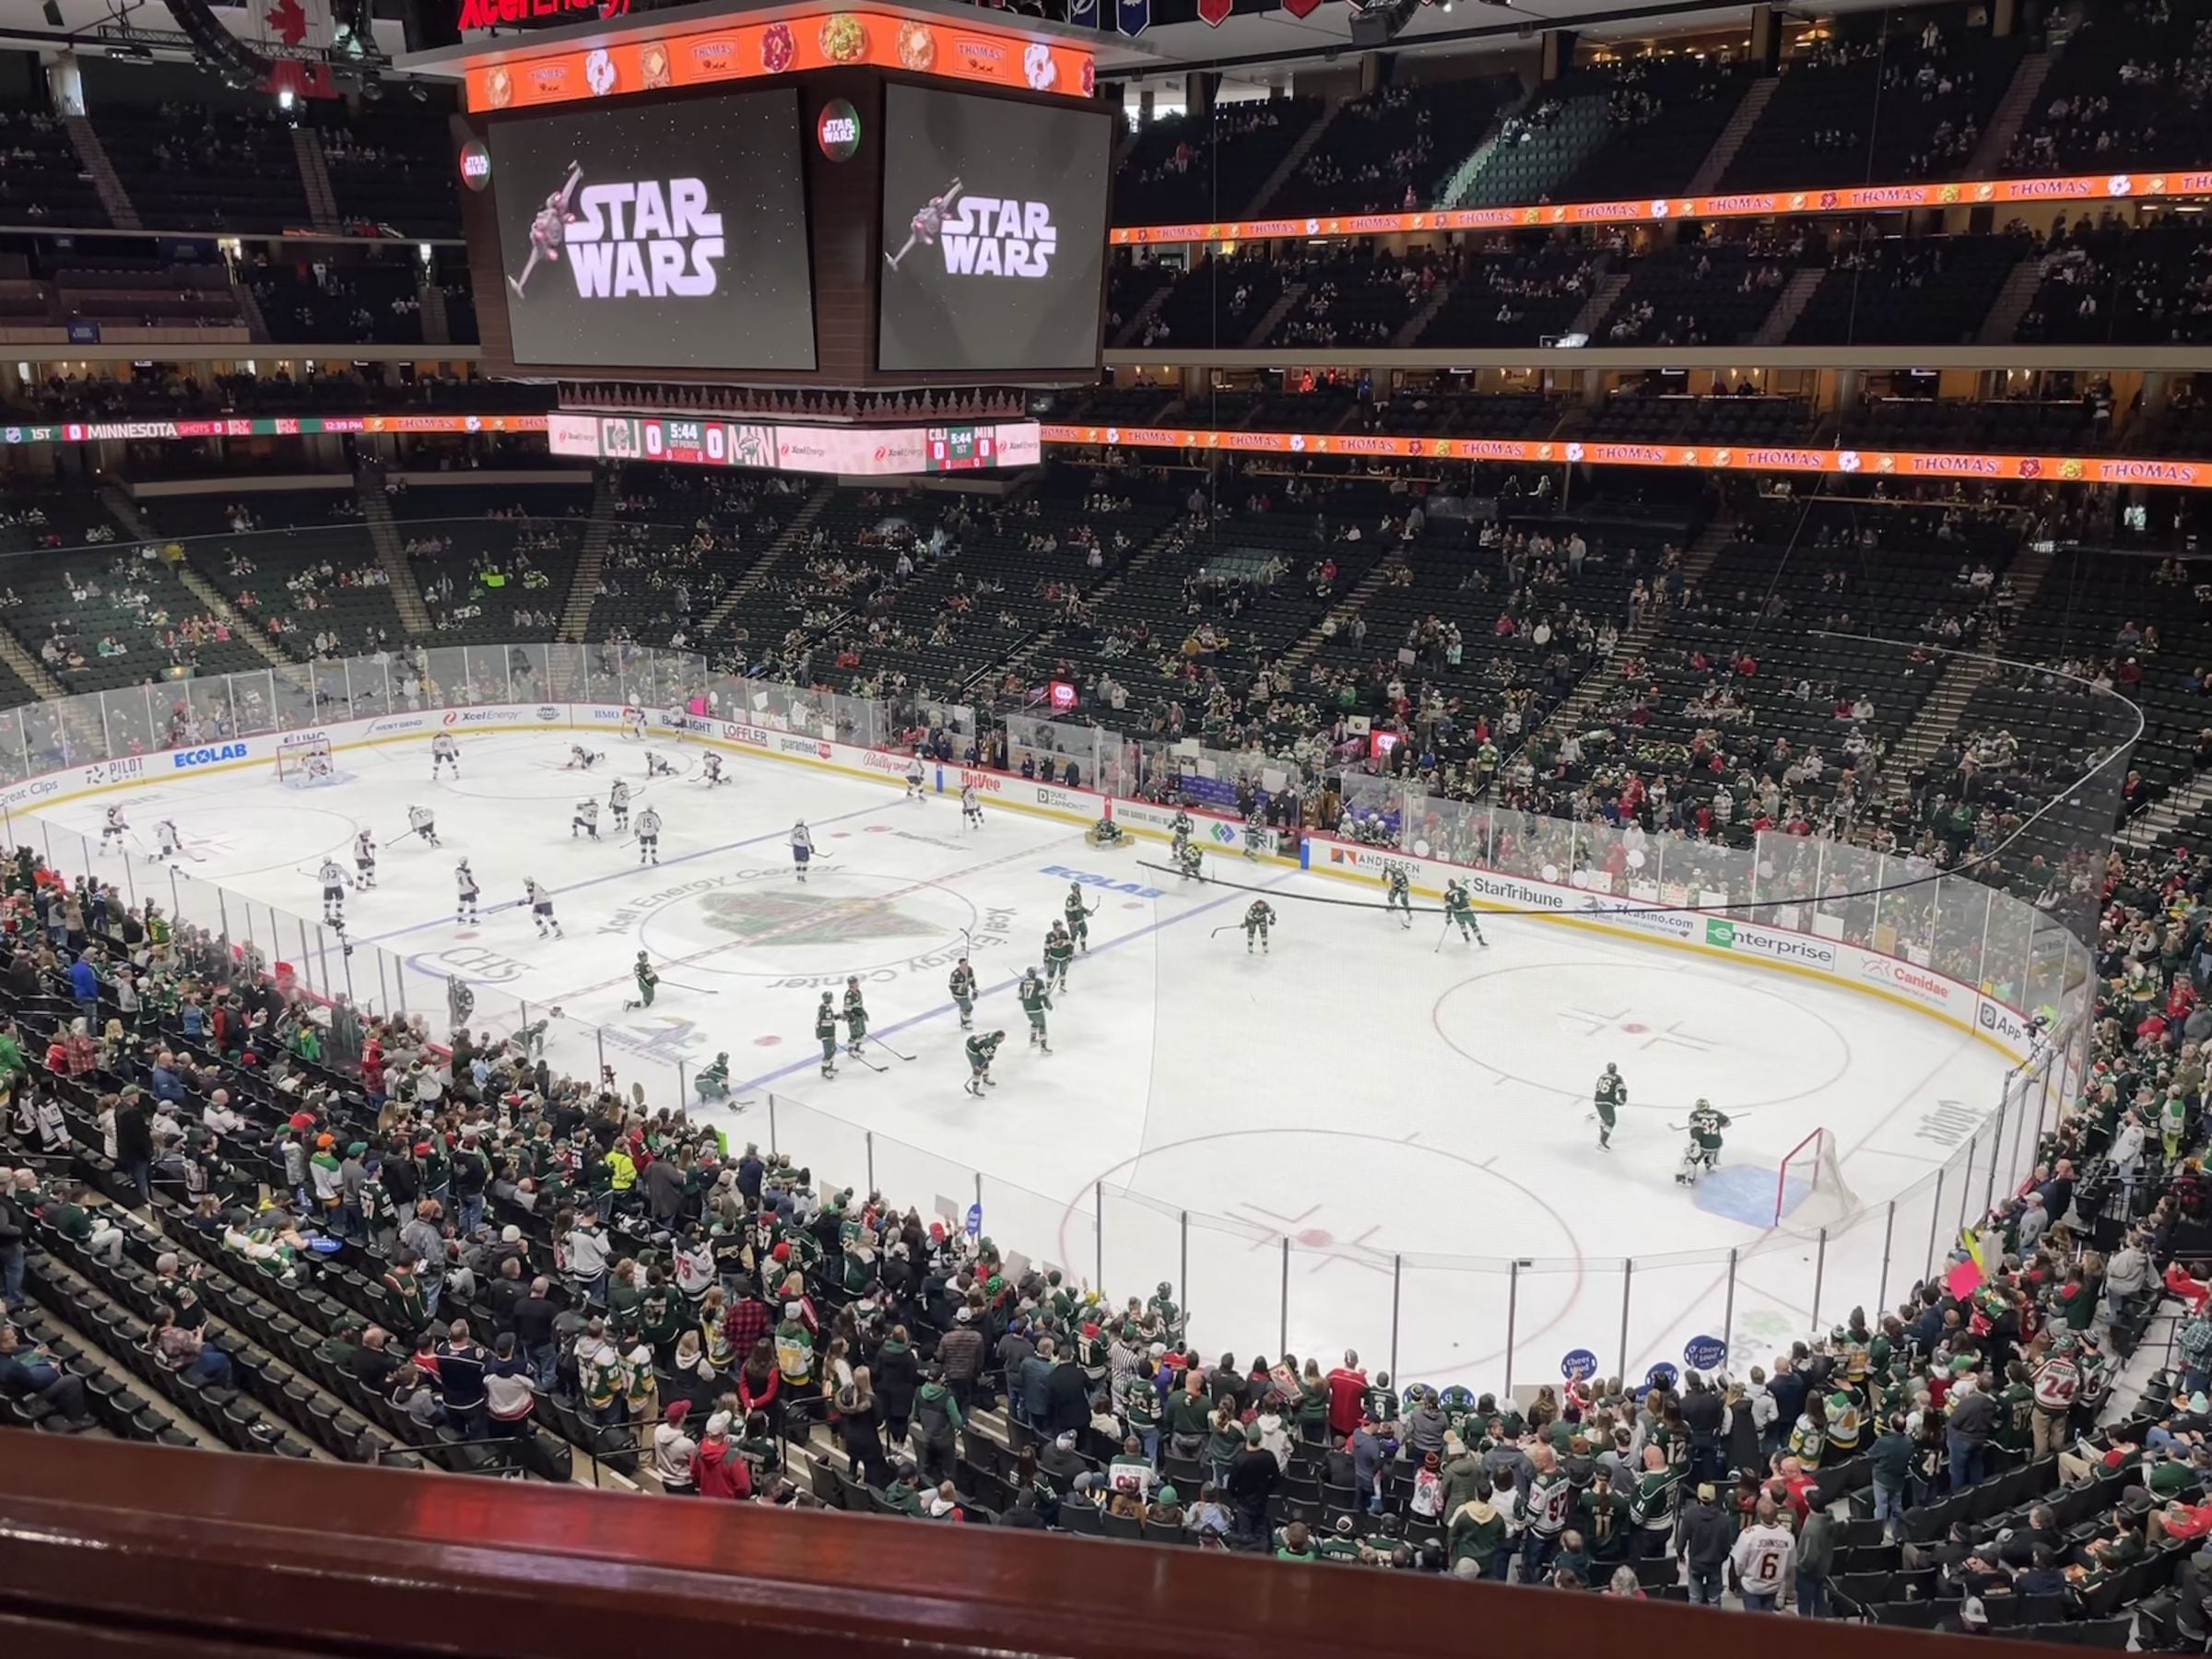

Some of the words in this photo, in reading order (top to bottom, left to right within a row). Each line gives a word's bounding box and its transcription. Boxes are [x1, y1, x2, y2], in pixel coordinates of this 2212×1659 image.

[823, 118, 854, 132] STAR
[823, 129, 855, 143] WARS
[465, 155, 487, 166] STAR
[465, 164, 488, 176] WARS
[565, 177, 724, 241] STAR
[940, 196, 1057, 241] STAR
[941, 235, 1056, 277] WARS
[565, 237, 724, 298] WARS
[30, 428, 51, 440] 1ST
[88, 421, 178, 440] MINNESOTA
[348, 420, 363, 430] PM
[670, 422, 699, 440] 5:44
[974, 426, 994, 440] MIN
[1041, 429, 1077, 439] HOMAS
[646, 425, 662, 454] 0
[707, 428, 724, 459] 0
[951, 432, 971, 445] 5:44
[980, 439, 989, 456] 0
[934, 441, 944, 459] 0
[722, 724, 767, 744] LOFFLER
[173, 743, 248, 769] ECOLAB
[109, 758, 144, 776] PILOT
[29, 779, 58, 795] Clips
[1358, 853, 1420, 874] ANDERSEN
[1038, 865, 1167, 899] ECOLAB
[596, 908, 642, 936] Xcel
[640, 875, 726, 909] Energy
[735, 864, 847, 880] Cener
[1474, 877, 1563, 909] StarTribune
[1712, 925, 1832, 963] enterprise
[1894, 968, 1948, 999] Canidae
[1700, 1119, 1718, 1135] 32
[1699, 1346, 1721, 1354] Cheer
[1567, 1356, 1590, 1366] Cheer
[2041, 1374, 2075, 1399] 24
[1666, 1441, 1687, 1464] 12
[1757, 1538, 1790, 1548] JOHNSON
[1760, 1552, 1780, 1580] 6
